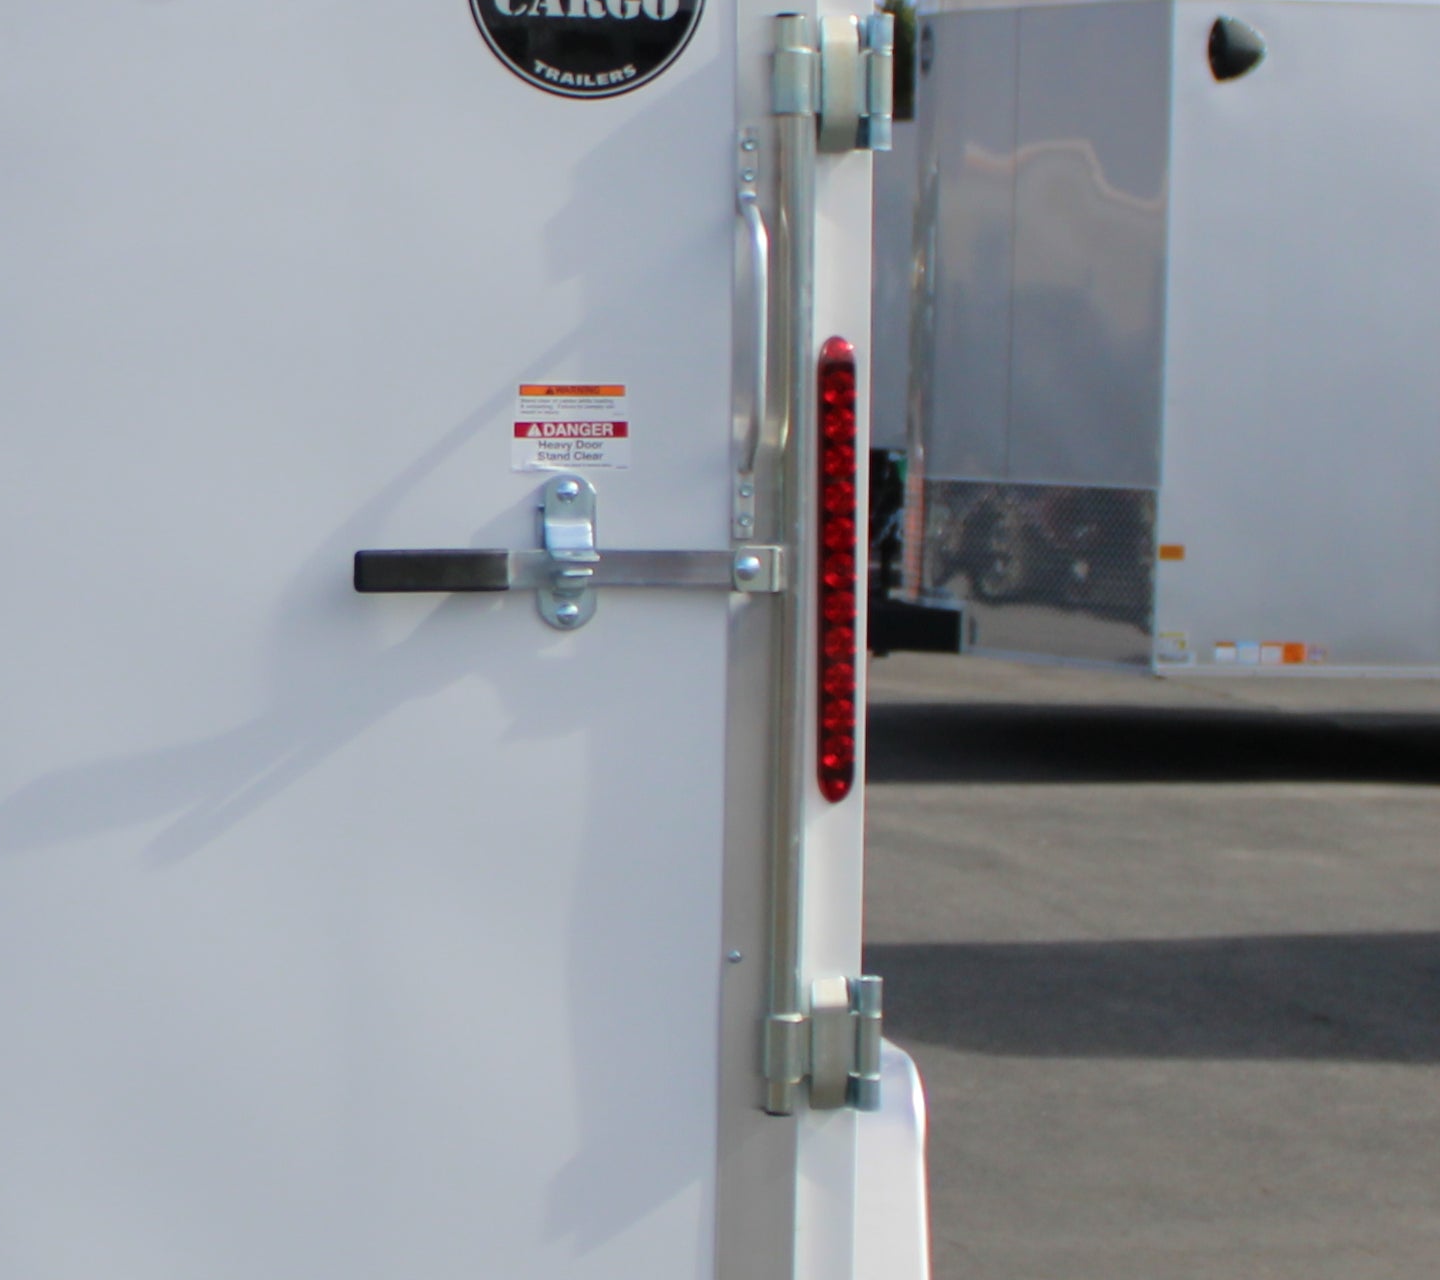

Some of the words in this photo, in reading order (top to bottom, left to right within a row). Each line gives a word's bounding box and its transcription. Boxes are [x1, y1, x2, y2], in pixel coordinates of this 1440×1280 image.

[533, 60, 638, 87] TRAILERS
[543, 423, 614, 437] DANGER
[538, 440, 573, 451] Heavy
[576, 440, 604, 450] Door
[538, 451, 571, 461] Stand
[574, 451, 604, 461] Clear
